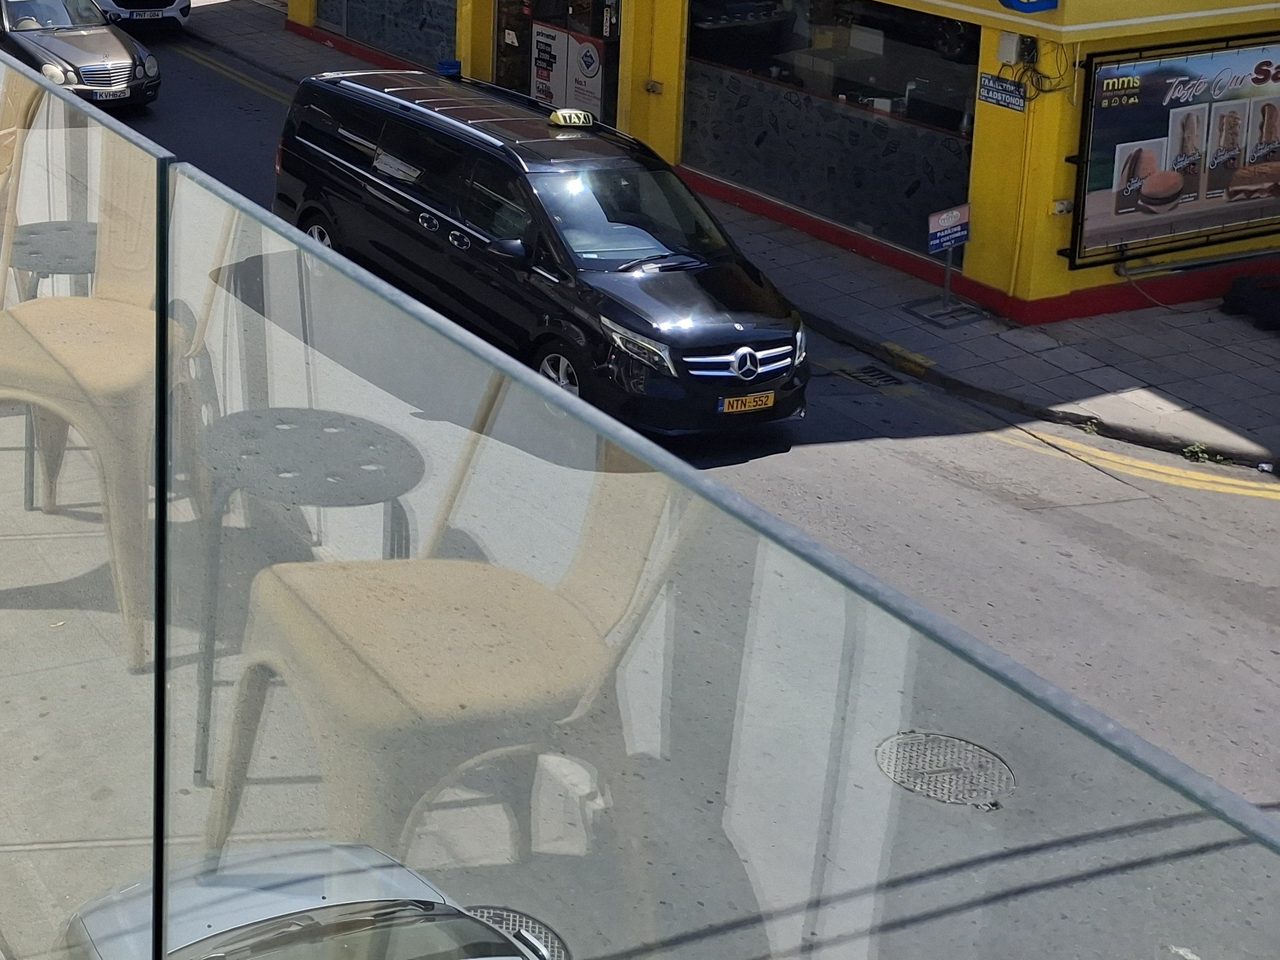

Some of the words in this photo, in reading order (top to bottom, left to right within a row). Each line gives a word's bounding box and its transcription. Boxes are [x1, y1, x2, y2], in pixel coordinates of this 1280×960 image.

[1103, 76, 1140, 91] mms
[1162, 76, 1208, 106] Taste
[1212, 67, 1252, 99] Our
[980, 88, 1024, 107] GLADSTONOS
[562, 113, 591, 125] TAXI
[727, 398, 748, 411] NTN
[752, 395, 770, 408] 552
